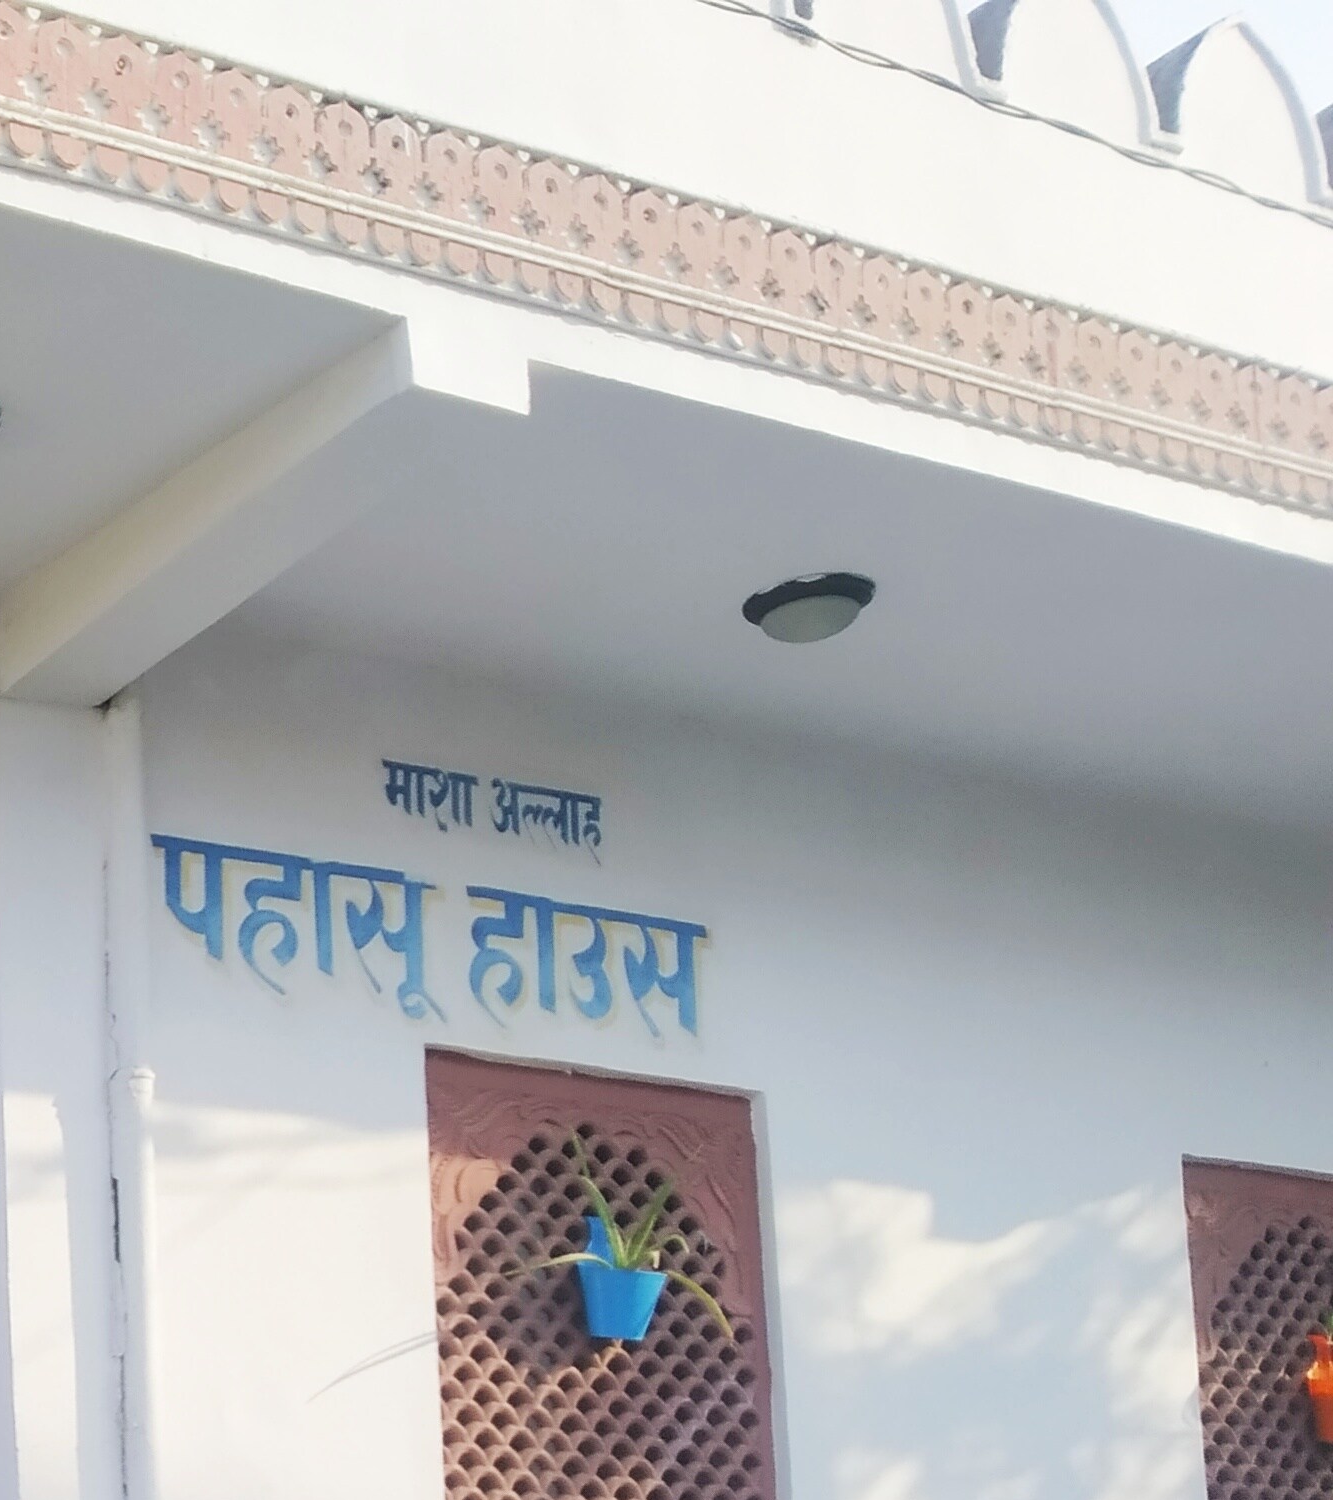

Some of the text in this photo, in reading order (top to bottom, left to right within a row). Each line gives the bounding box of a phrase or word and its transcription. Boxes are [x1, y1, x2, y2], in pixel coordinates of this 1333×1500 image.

[381, 758, 478, 831] माशा
[150, 833, 707, 1037] पहासू हाउस
